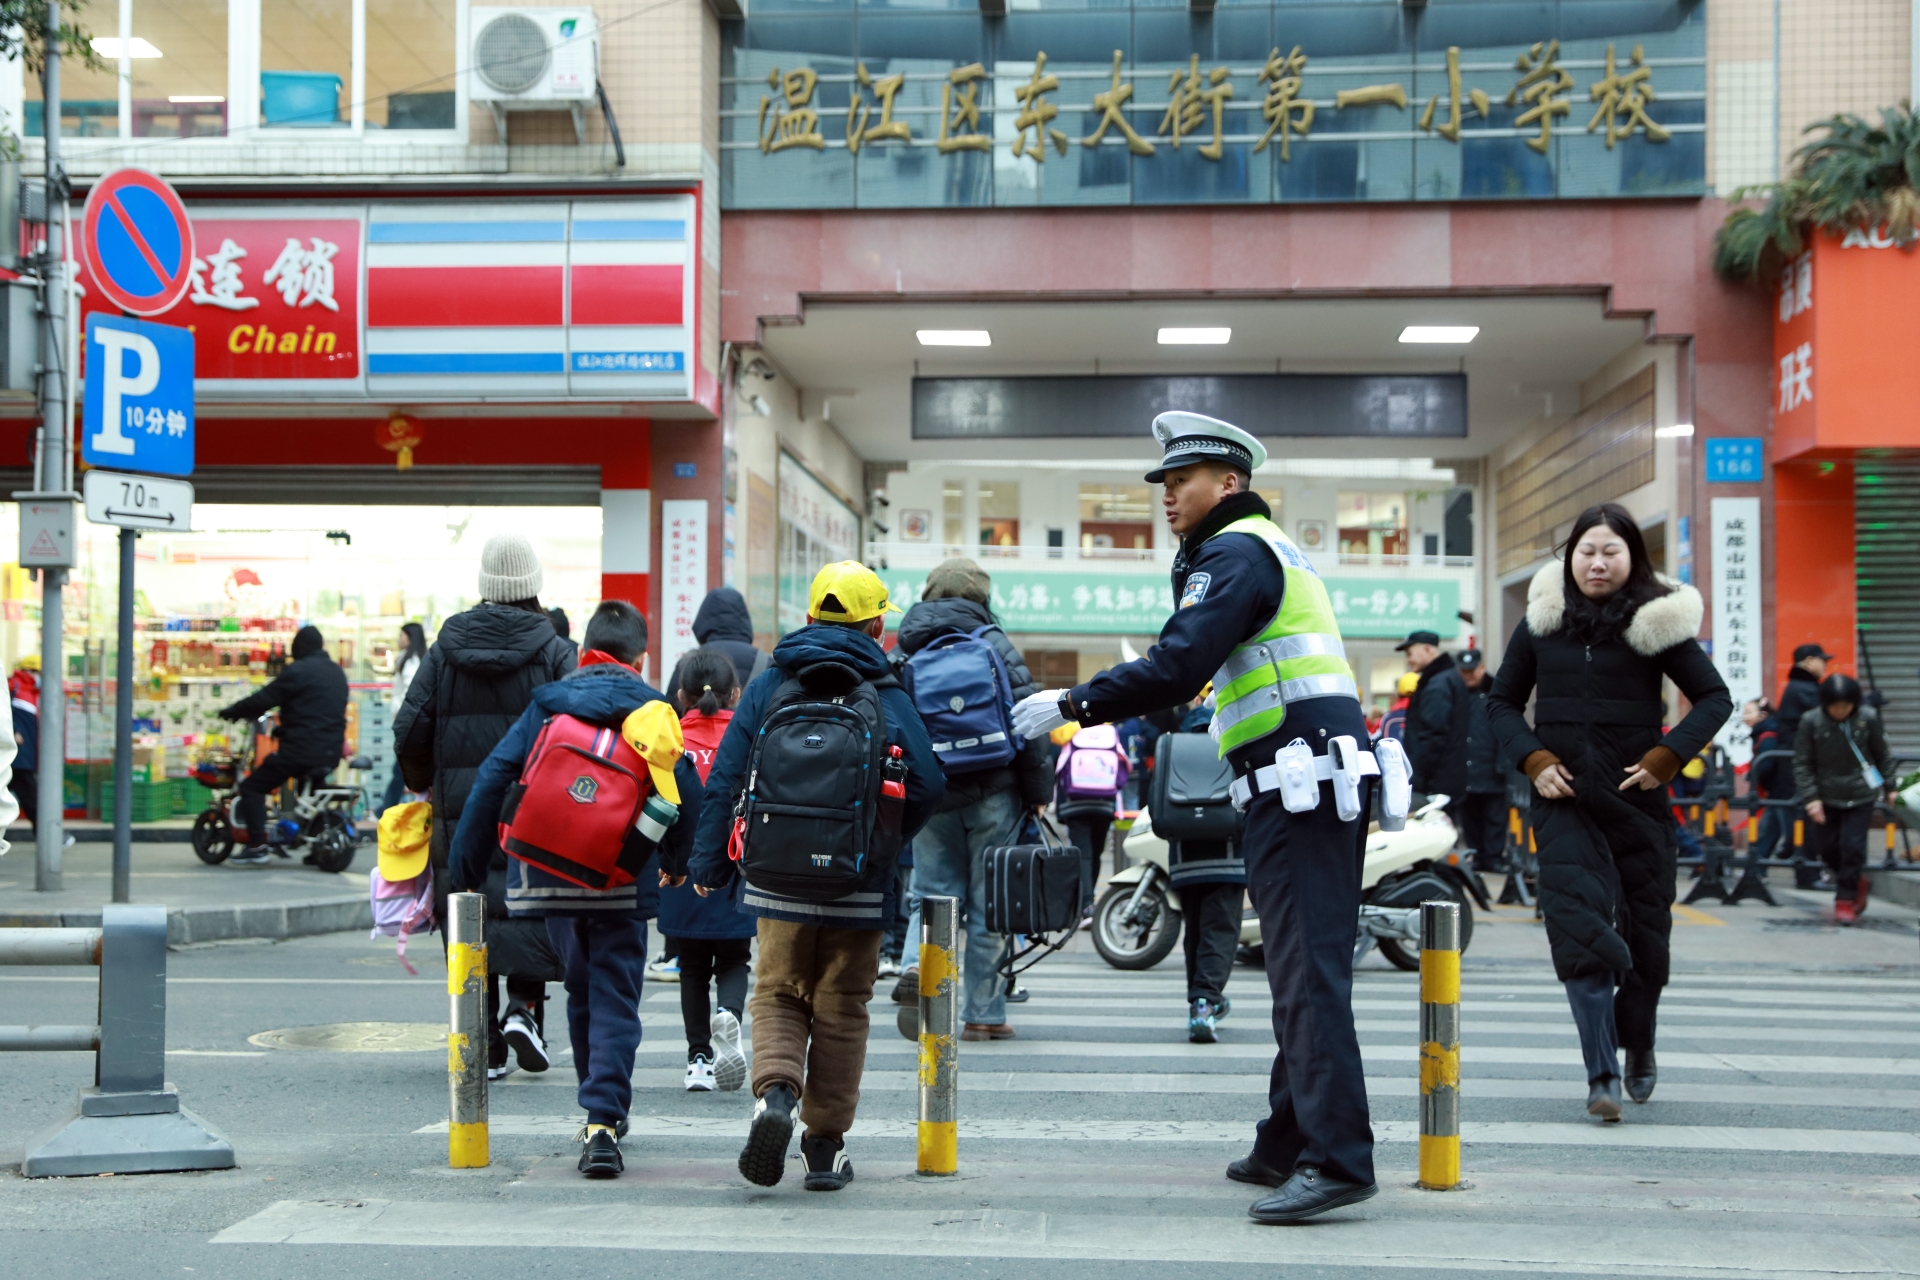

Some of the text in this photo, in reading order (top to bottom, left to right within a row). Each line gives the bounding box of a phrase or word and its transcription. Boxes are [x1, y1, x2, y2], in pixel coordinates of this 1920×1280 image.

[757, 42, 1671, 163] 温江区东大街第一小学校
[228, 324, 337, 354] Chain
[92, 326, 161, 456] P
[126, 406, 187, 438] 10分钟
